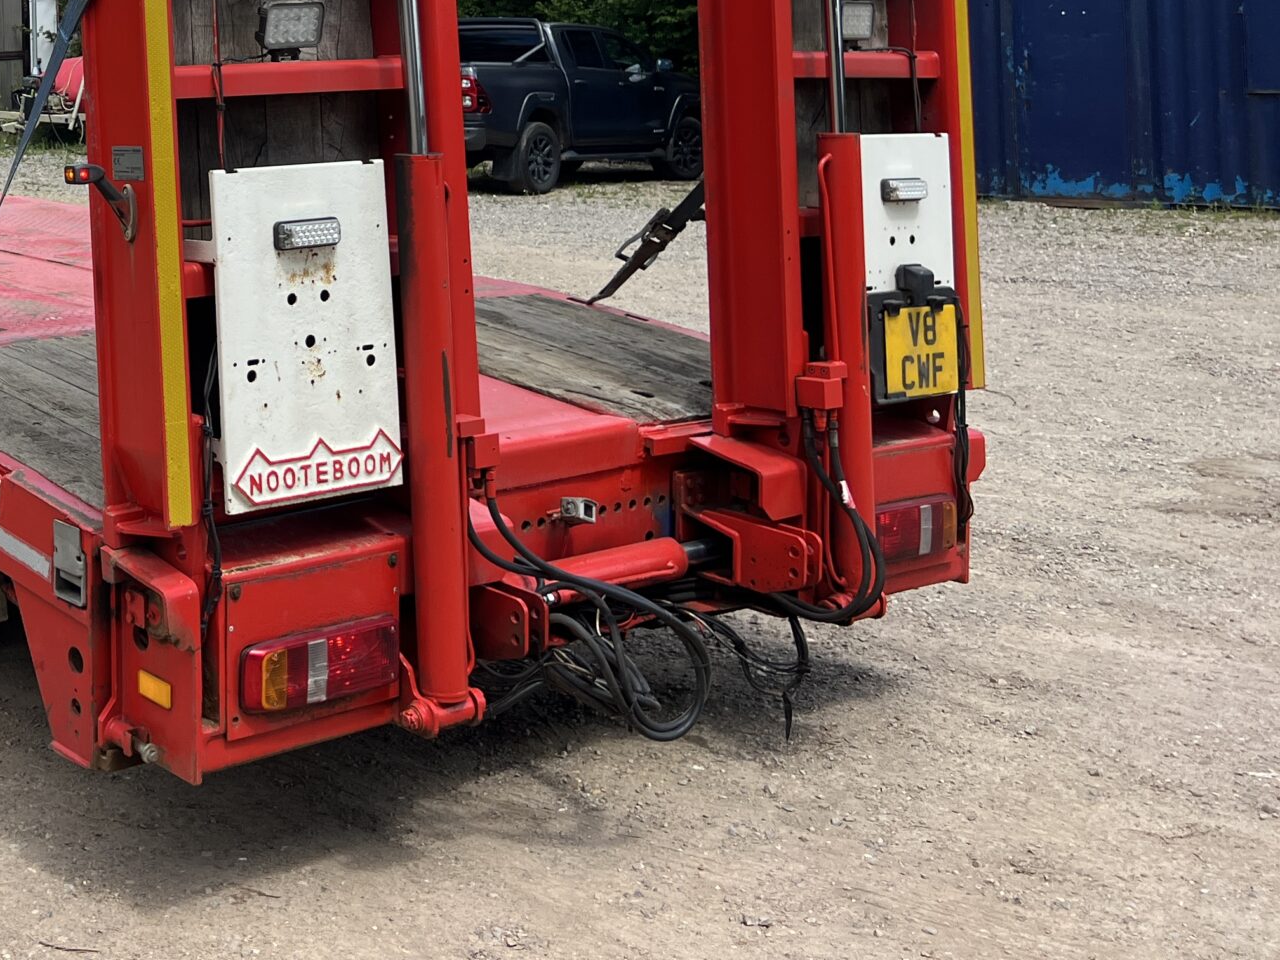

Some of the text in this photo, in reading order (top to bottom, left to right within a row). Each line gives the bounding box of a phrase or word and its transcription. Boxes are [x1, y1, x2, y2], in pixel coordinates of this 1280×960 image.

[908, 310, 936, 347] V8
[901, 351, 945, 391] CWF
[249, 452, 392, 497] NOOTEBOOM
